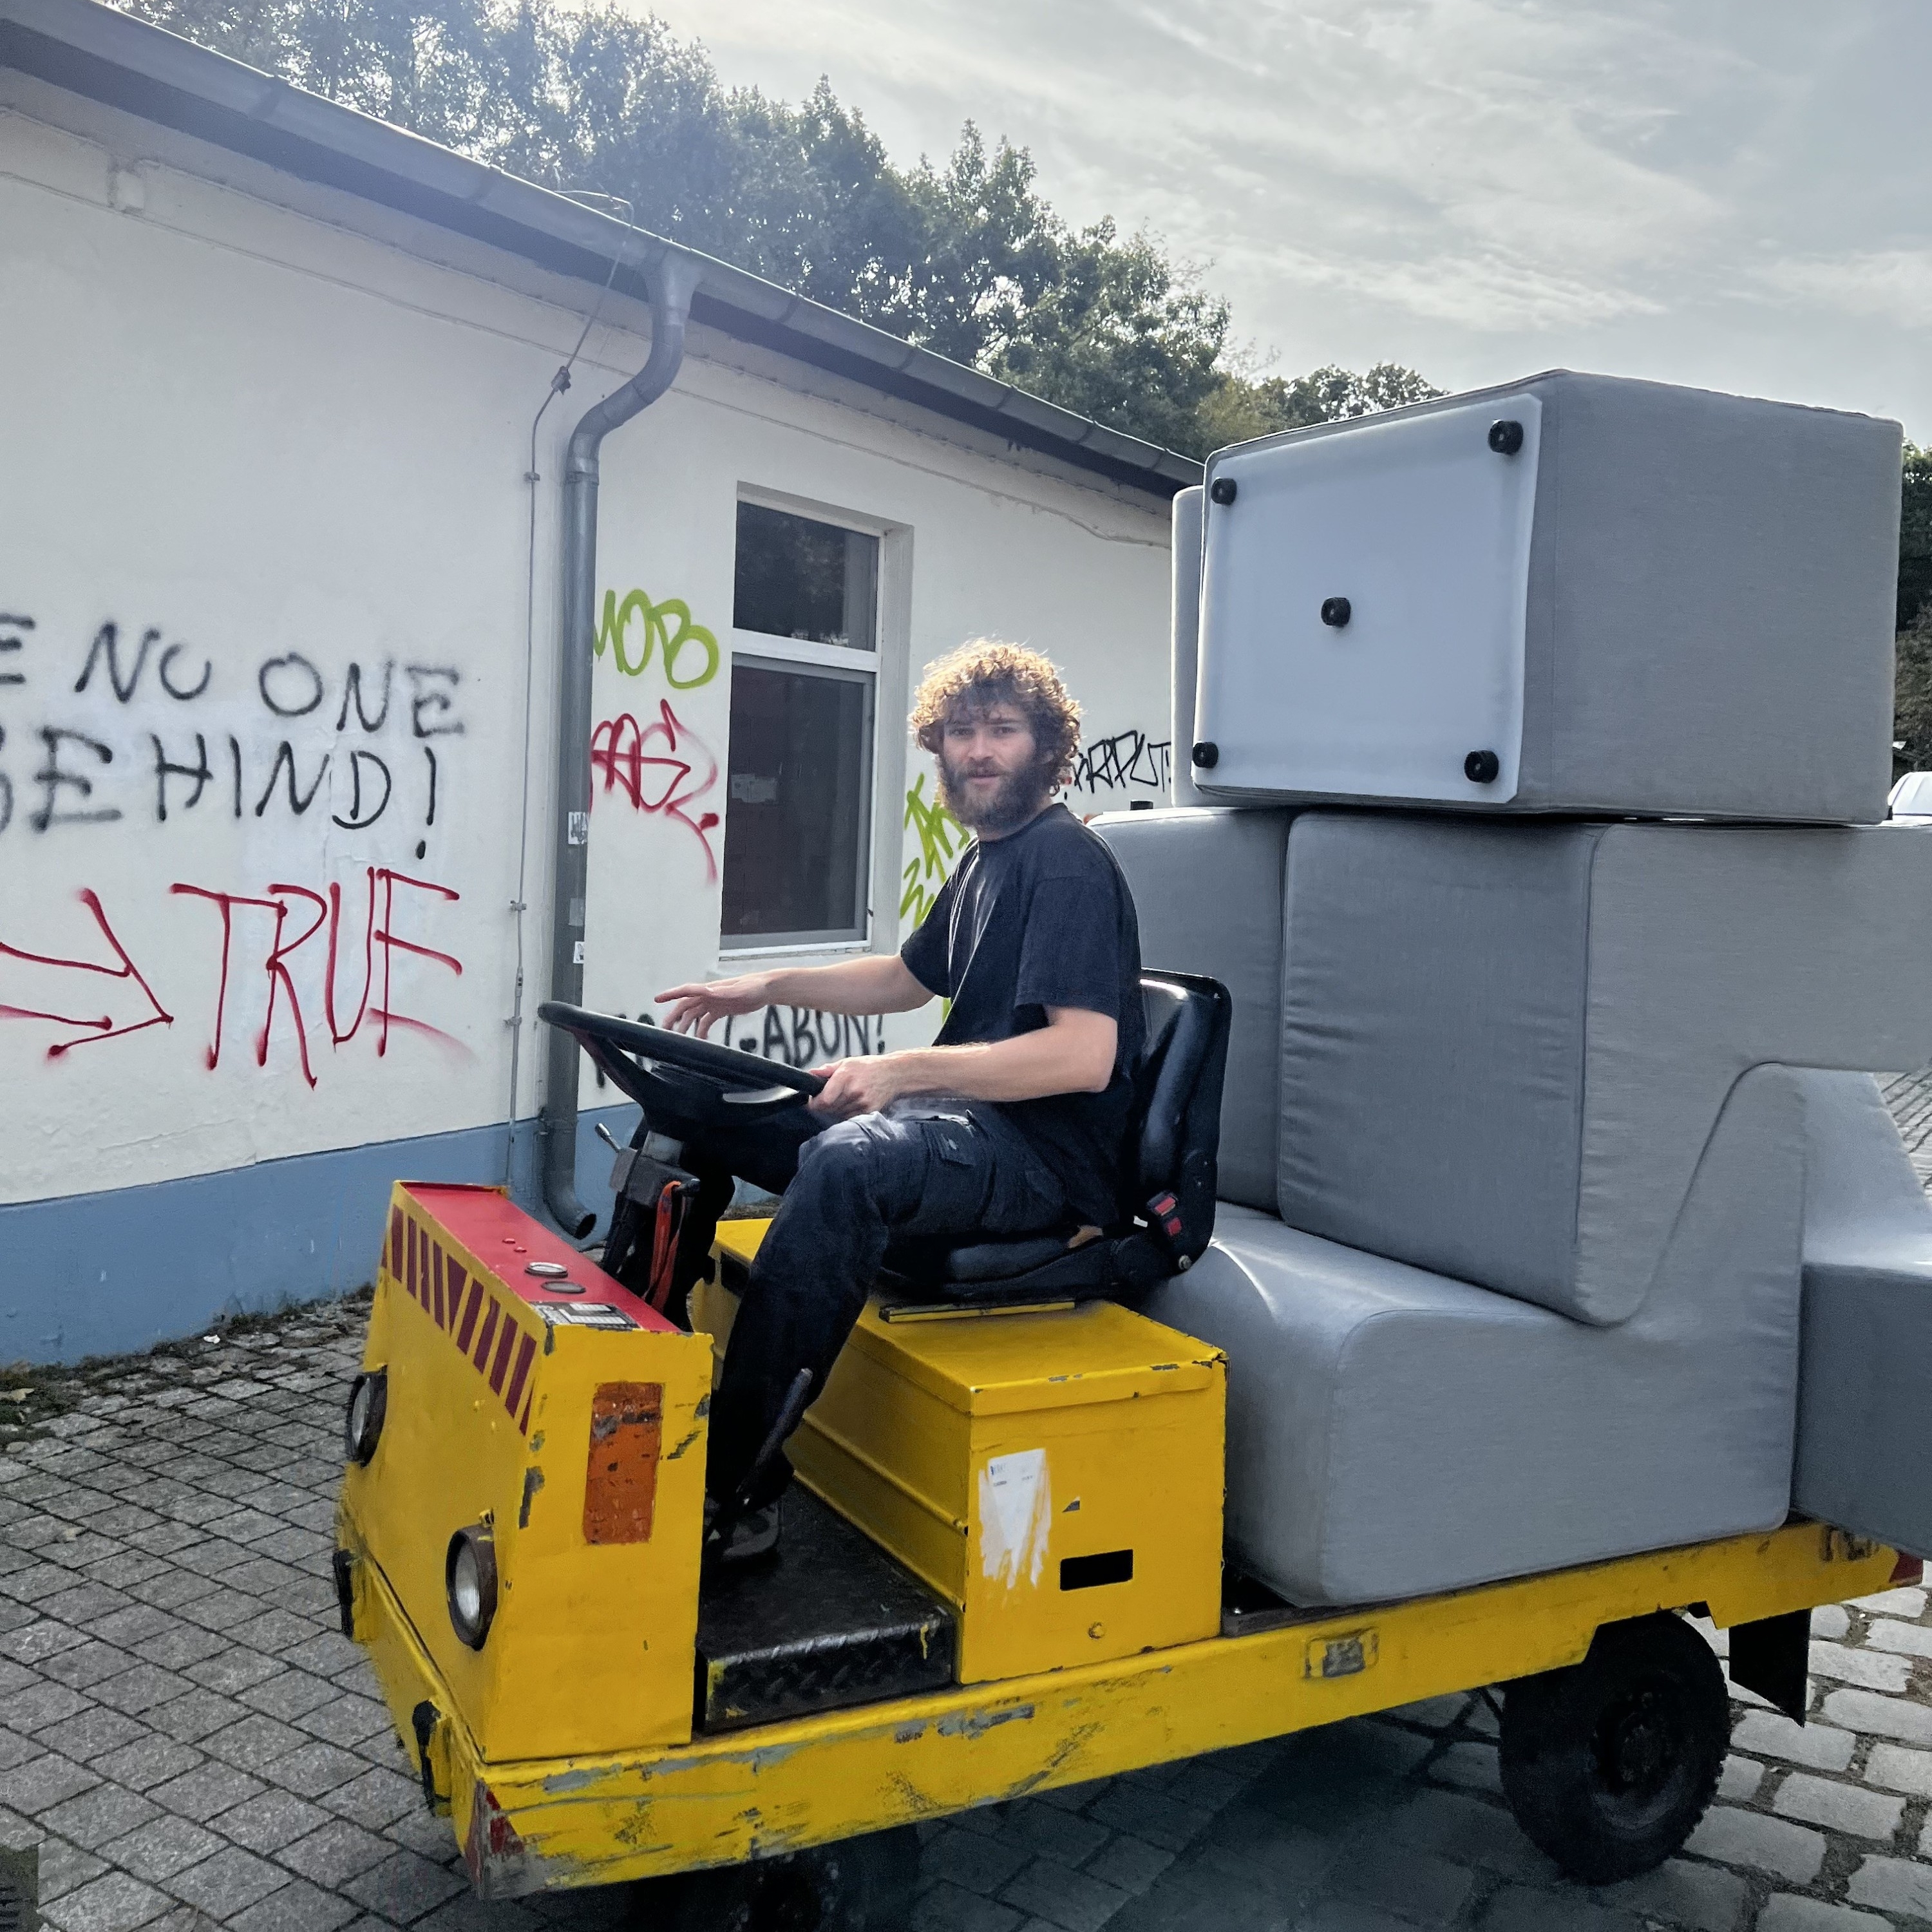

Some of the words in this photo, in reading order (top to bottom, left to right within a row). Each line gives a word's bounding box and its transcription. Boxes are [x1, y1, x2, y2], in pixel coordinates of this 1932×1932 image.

[73, 620, 213, 703] NO
[259, 652, 466, 739] ONE
[169, 866, 469, 1091] TRUE
